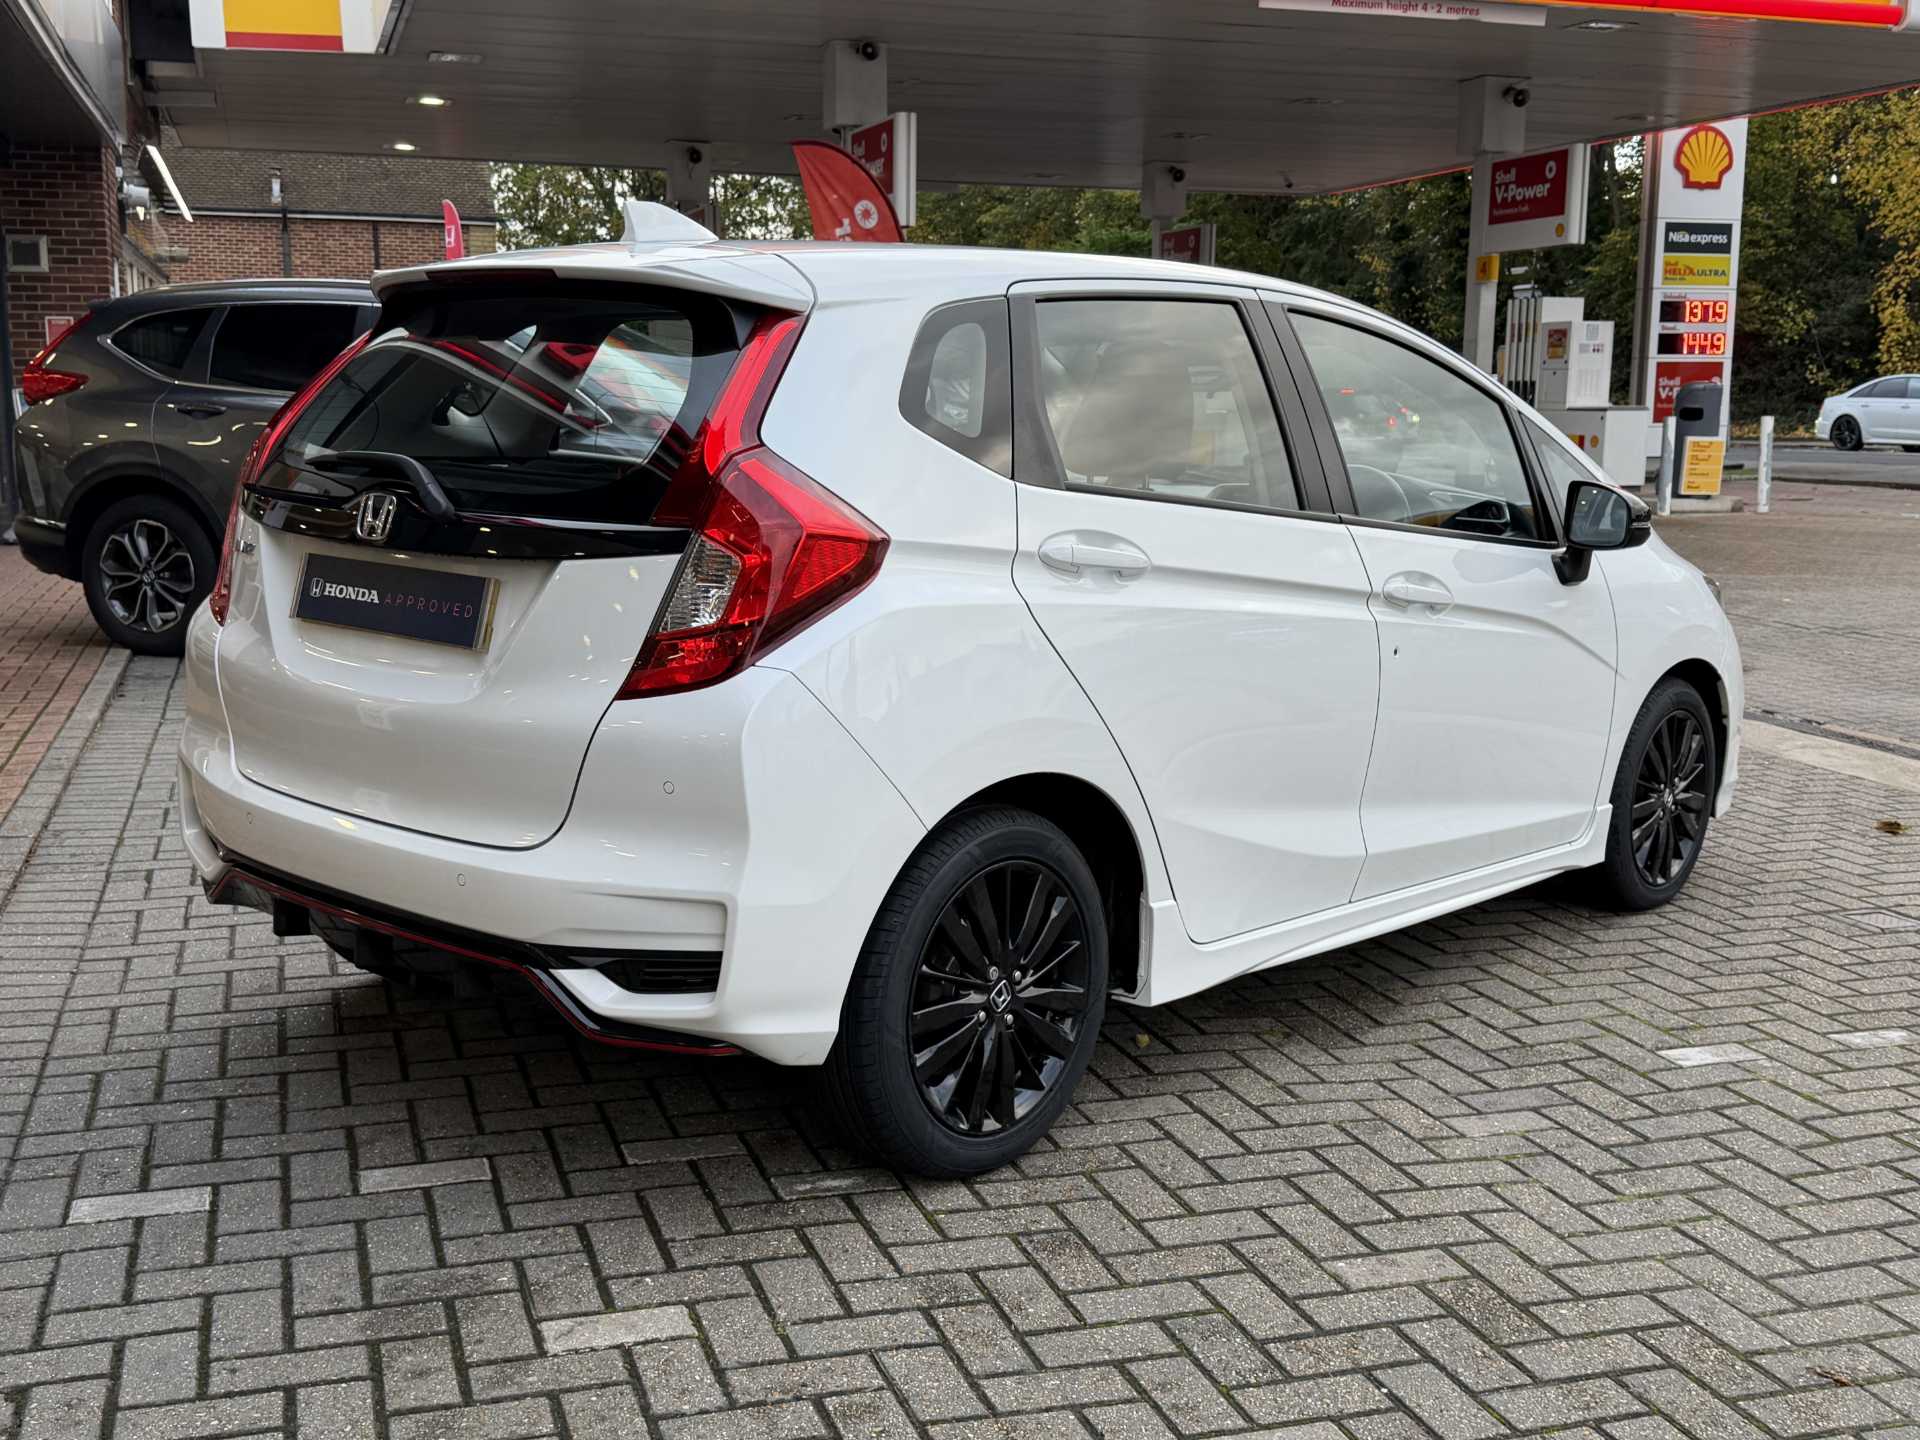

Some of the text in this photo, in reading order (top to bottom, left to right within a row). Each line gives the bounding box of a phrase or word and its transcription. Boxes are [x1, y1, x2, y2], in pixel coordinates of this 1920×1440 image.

[1331, 0, 1383, 9] Maximum
[1386, 0, 1418, 13] height
[1446, 5, 1481, 16] metres
[1495, 167, 1517, 184] Shell
[1495, 182, 1551, 204] V-Power
[1696, 268, 1727, 277] ULTRA
[1685, 301, 1727, 323] 137.9
[1682, 333, 1725, 355] 144.9
[1659, 376, 1681, 386] Shell
[323, 582, 474, 618] HONDA APPROVED
